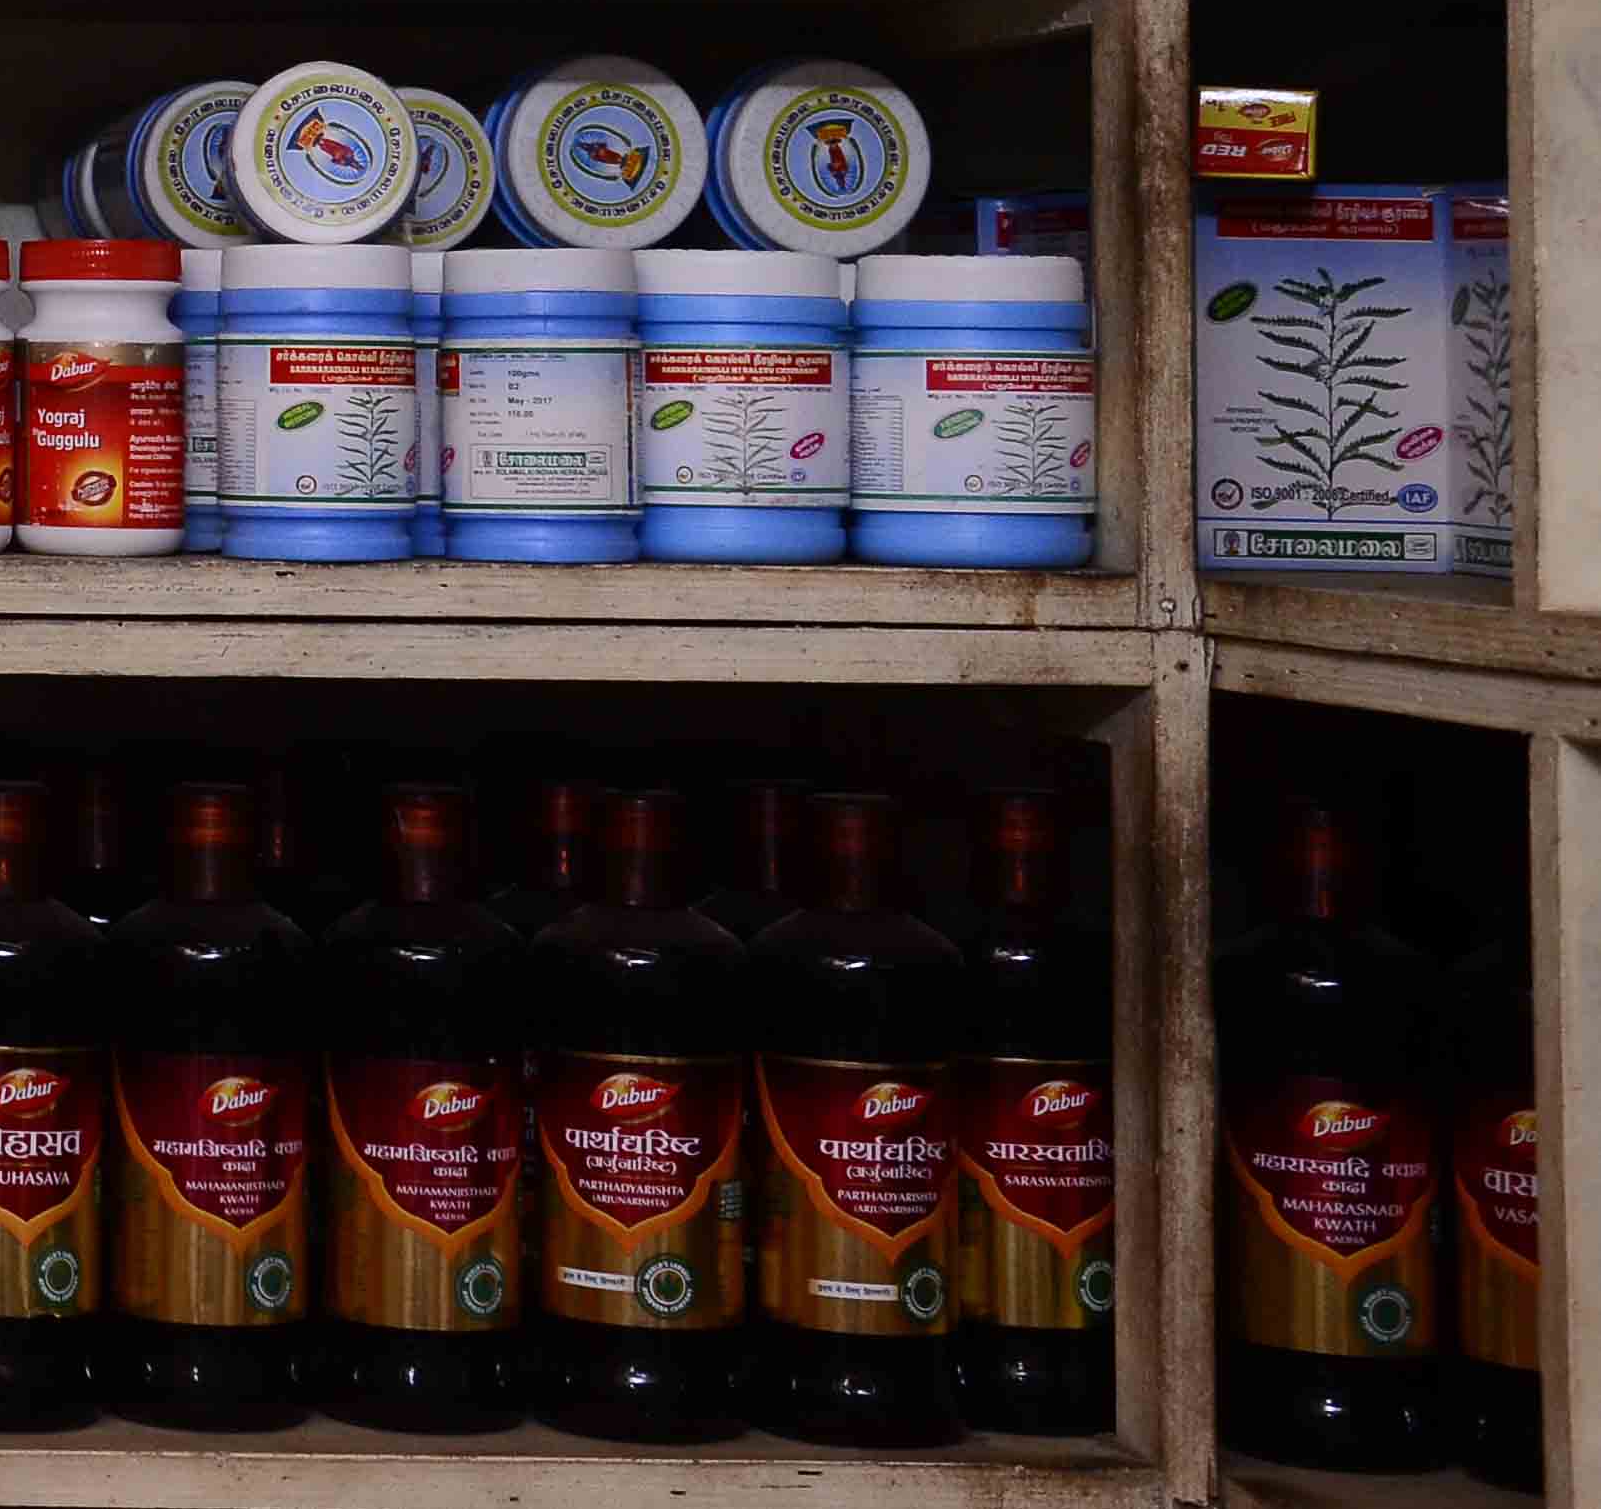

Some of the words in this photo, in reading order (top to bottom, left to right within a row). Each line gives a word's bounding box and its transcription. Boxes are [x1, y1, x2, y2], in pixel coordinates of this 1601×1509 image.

[1200, 144, 1247, 157] RED
[49, 360, 97, 381] Dabur
[37, 408, 86, 428] Yograj
[36, 429, 100, 449] Guggulu
[1250, 488, 1273, 500] ISO
[1274, 488, 1301, 500] 9001
[1341, 489, 1391, 502] Certified
[1404, 492, 1431, 505] IAF
[1250, 532, 1403, 559] சோலைமலை
[578, 1178, 686, 1197] PARTHADYARISHTA
[218, 1194, 260, 1204] KWATH
[429, 1199, 471, 1210] KWATH
[1283, 1196, 1404, 1218] MAHARASNADI
[1313, 1218, 1377, 1232] KWATH
